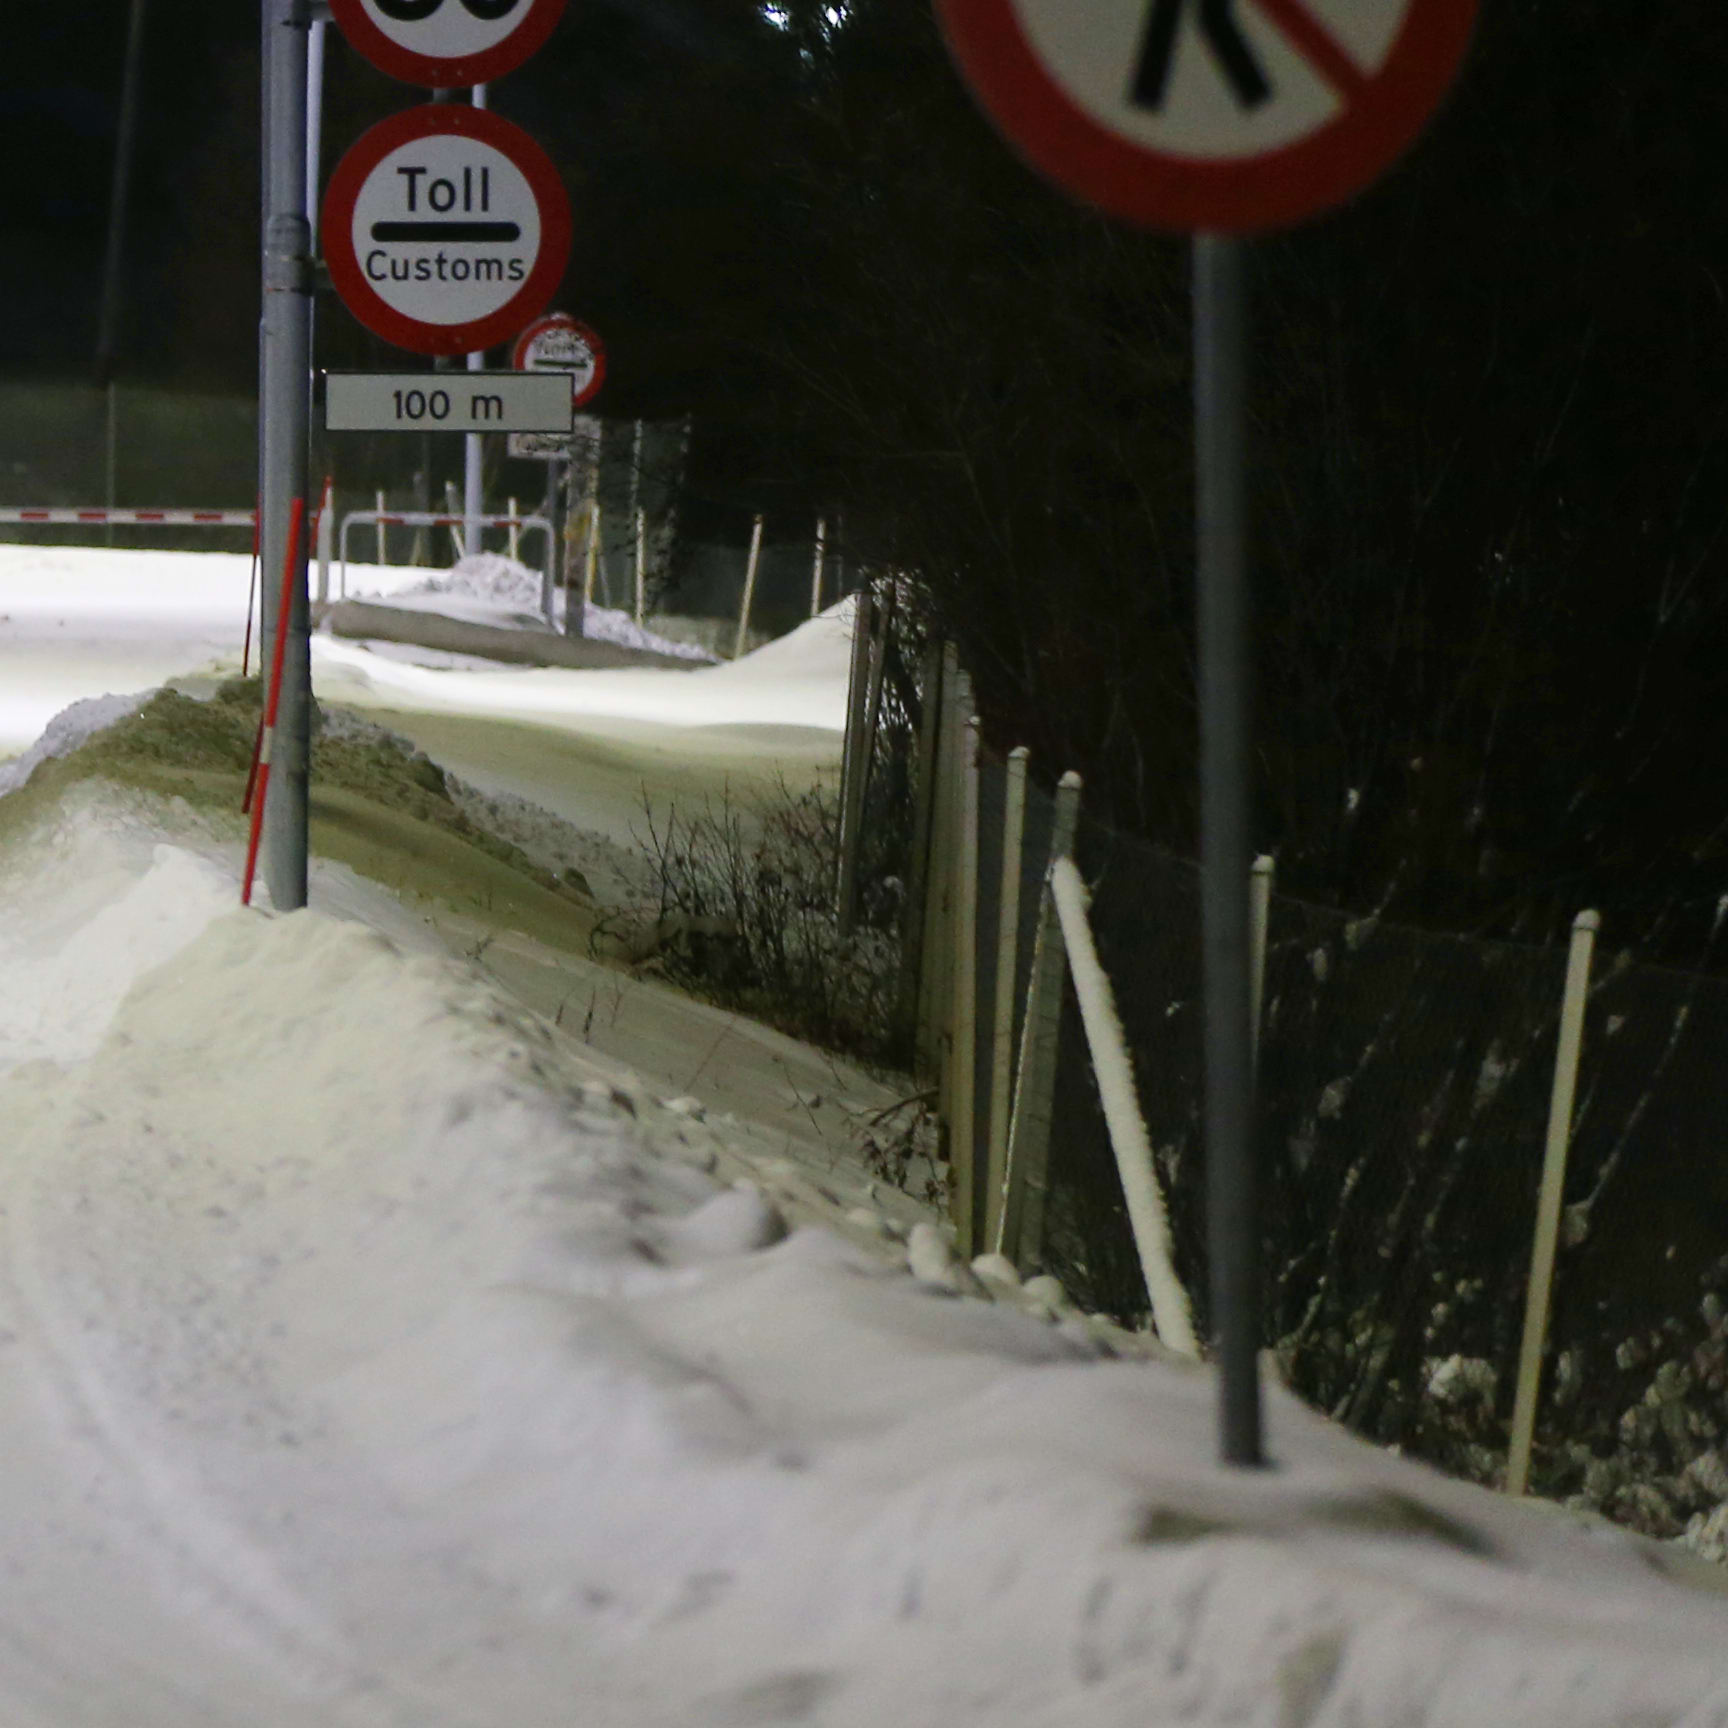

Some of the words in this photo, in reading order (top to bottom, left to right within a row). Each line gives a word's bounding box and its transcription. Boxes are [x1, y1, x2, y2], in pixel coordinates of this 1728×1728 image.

[396, 167, 490, 213] Toll
[365, 250, 525, 282] Customs
[392, 389, 451, 421] 100
[471, 394, 504, 420] m
